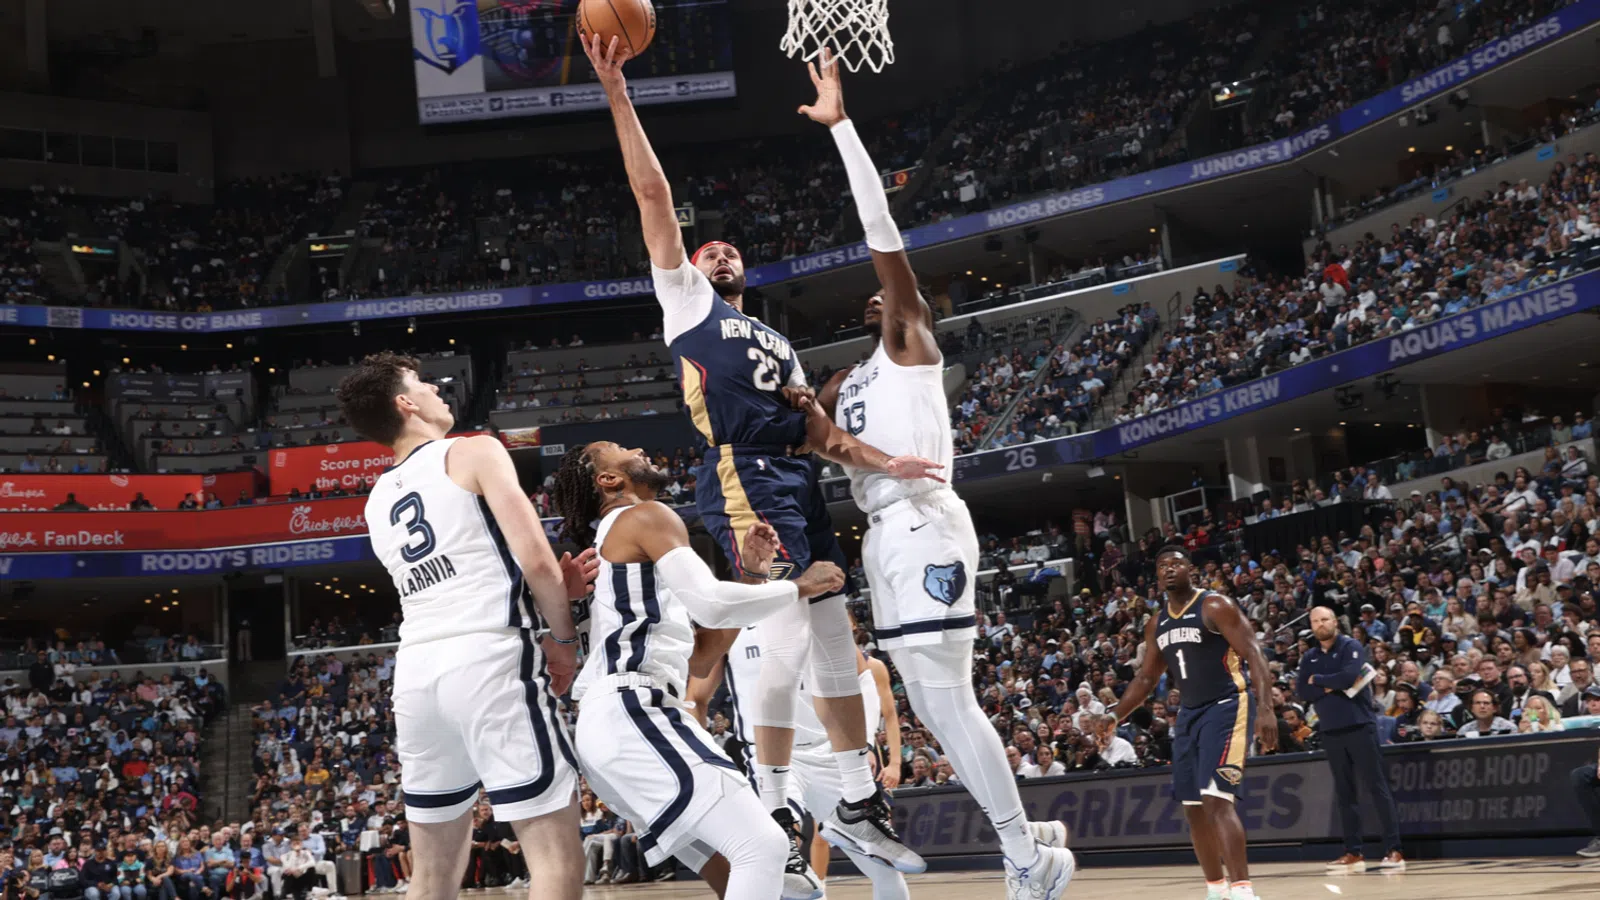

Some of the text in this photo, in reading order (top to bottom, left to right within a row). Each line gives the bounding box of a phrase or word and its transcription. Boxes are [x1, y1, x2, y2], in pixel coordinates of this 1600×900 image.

[1402, 17, 1562, 102] SANTI'S SCORERS
[1190, 145, 1279, 179] JUNIOR'S
[988, 188, 1105, 228] MOOR ROSES
[791, 250, 846, 275] LUKE'S
[345, 293, 503, 318] #MUCHREQUIRED
[111, 312, 262, 330] HOUSE OF BANE
[720, 318, 752, 339] NEW
[1388, 283, 1578, 361] AQUA'S MANES
[843, 400, 866, 436] 13
[1119, 377, 1281, 444] KONCHAR'S KREW
[320, 458, 360, 471] Score
[1004, 447, 1038, 471] 26
[316, 476, 340, 488] the
[44, 530, 124, 546] FanDeck
[390, 491, 437, 563] 3
[142, 542, 335, 571] RODDY'S RIDERS
[1170, 626, 1202, 644] ORLEANS
[1175, 649, 1187, 680] 1
[1389, 752, 1550, 792] 901.888.HOOP
[1477, 796, 1509, 820] THE
[1511, 794, 1548, 818] APP
